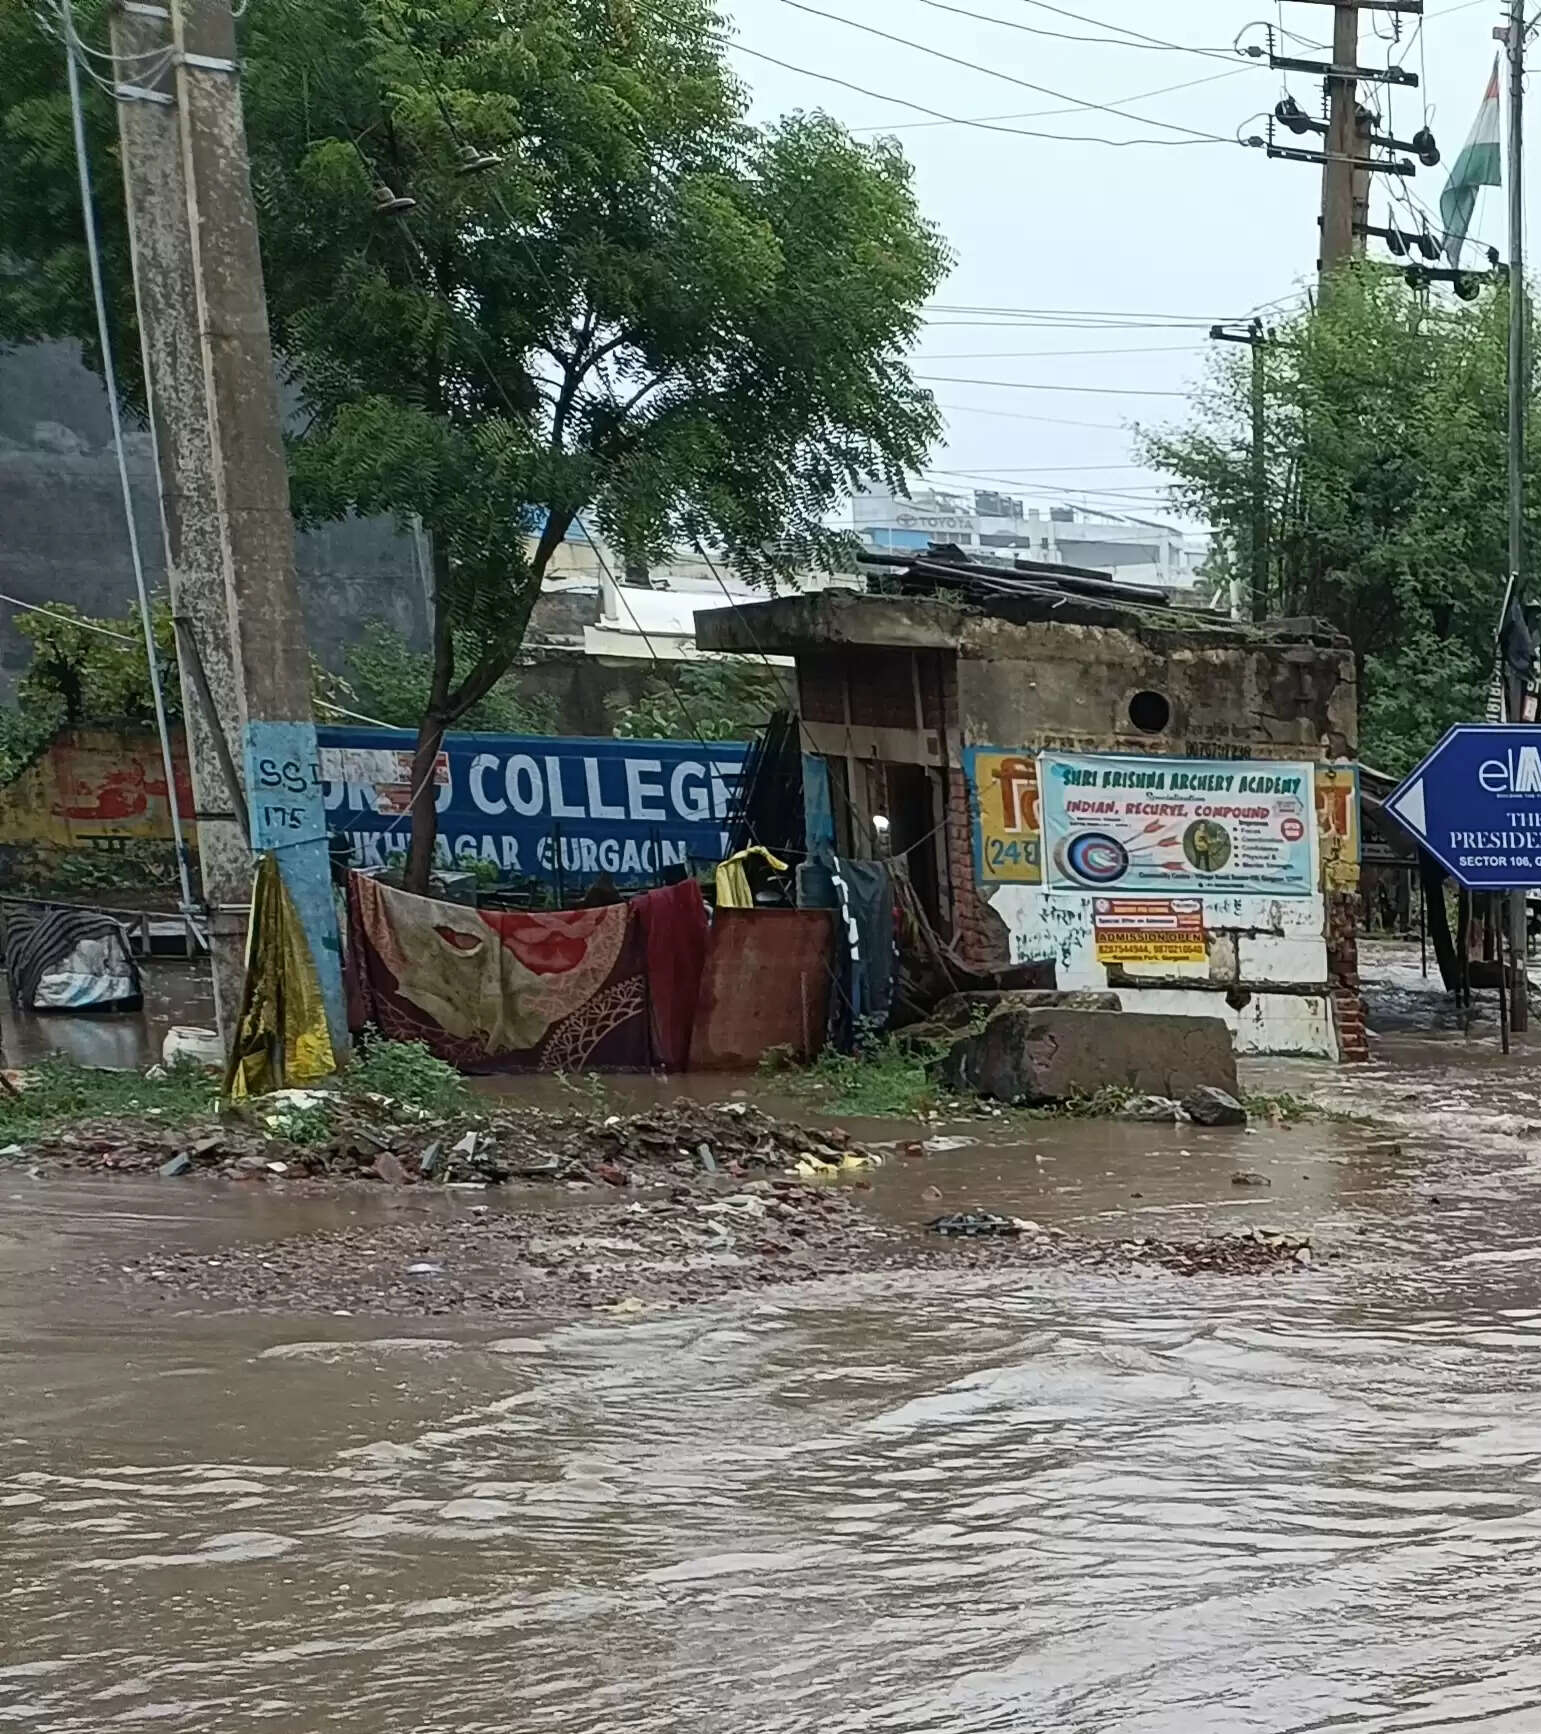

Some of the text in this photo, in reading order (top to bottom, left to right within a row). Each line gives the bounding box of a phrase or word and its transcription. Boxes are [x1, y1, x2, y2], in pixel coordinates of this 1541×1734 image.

[1063, 768, 1302, 795] SHRI KRISHNA ARCHERY ACADEMY
[264, 806, 306, 829] 175
[1066, 800, 1119, 815] INDIAN,
[1194, 804, 1270, 819] COMPOUND
[1459, 856, 1507, 867] SECTOR
[1100, 931, 1201, 942] ADMISSION OPEN
